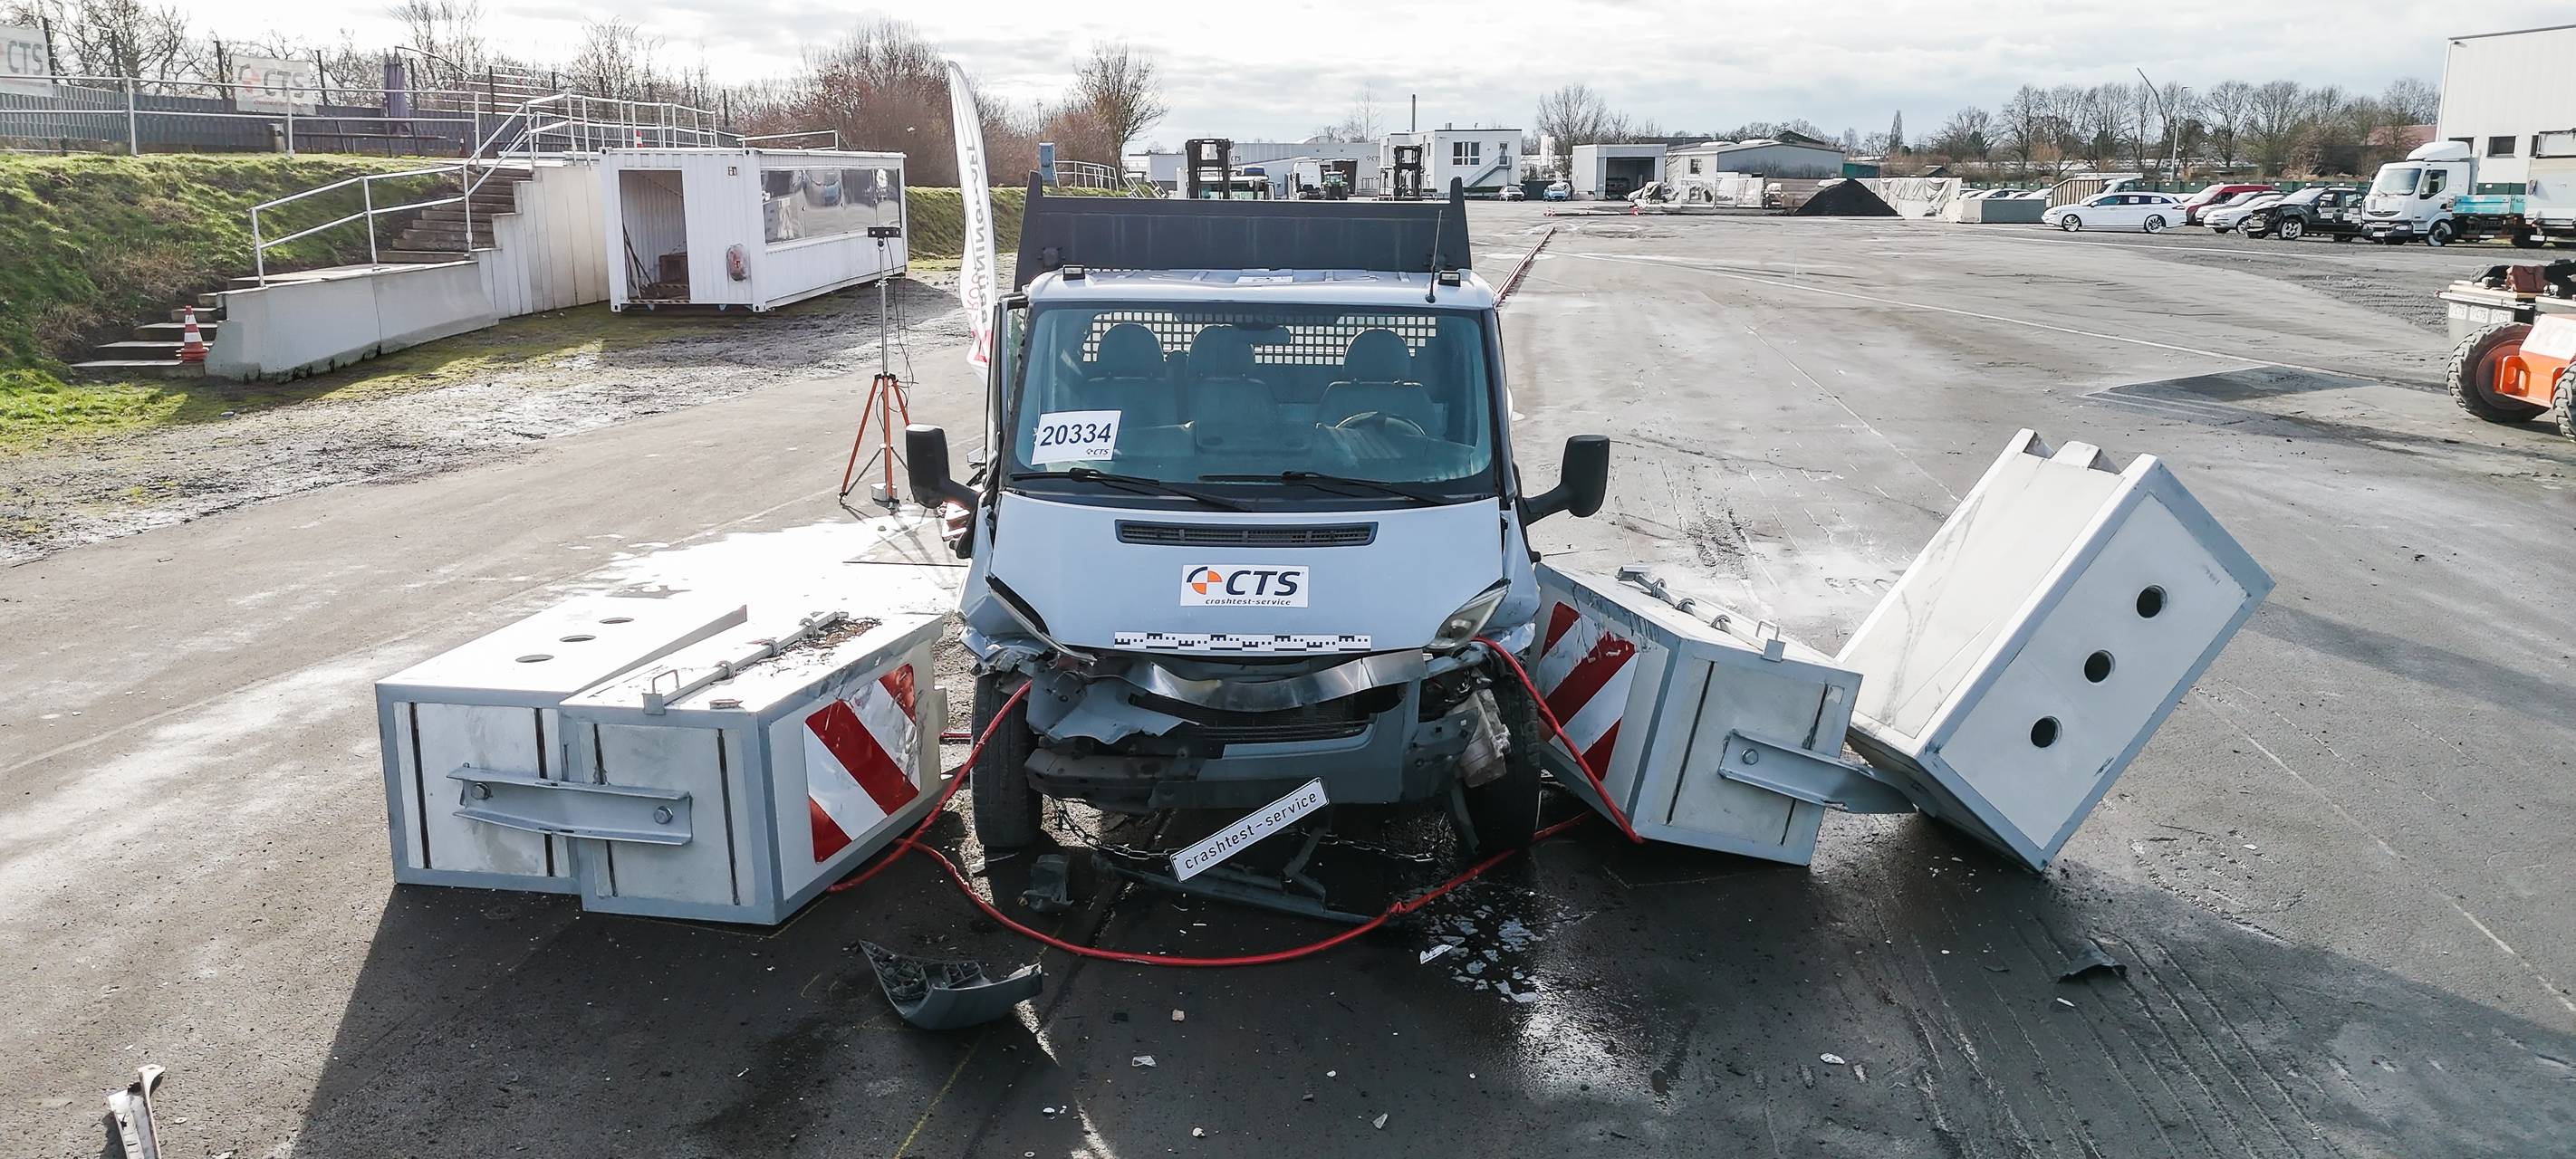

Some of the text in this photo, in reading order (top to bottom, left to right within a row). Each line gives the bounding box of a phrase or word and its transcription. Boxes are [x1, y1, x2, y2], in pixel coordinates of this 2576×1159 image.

[7, 40, 43, 75] CTS
[264, 70, 304, 98] CTS
[1040, 423, 1111, 446] 20334
[1226, 570, 1301, 596] CTS
[1206, 598, 1292, 606] crashtest-service
[1185, 791, 1317, 869] crashtest-service
